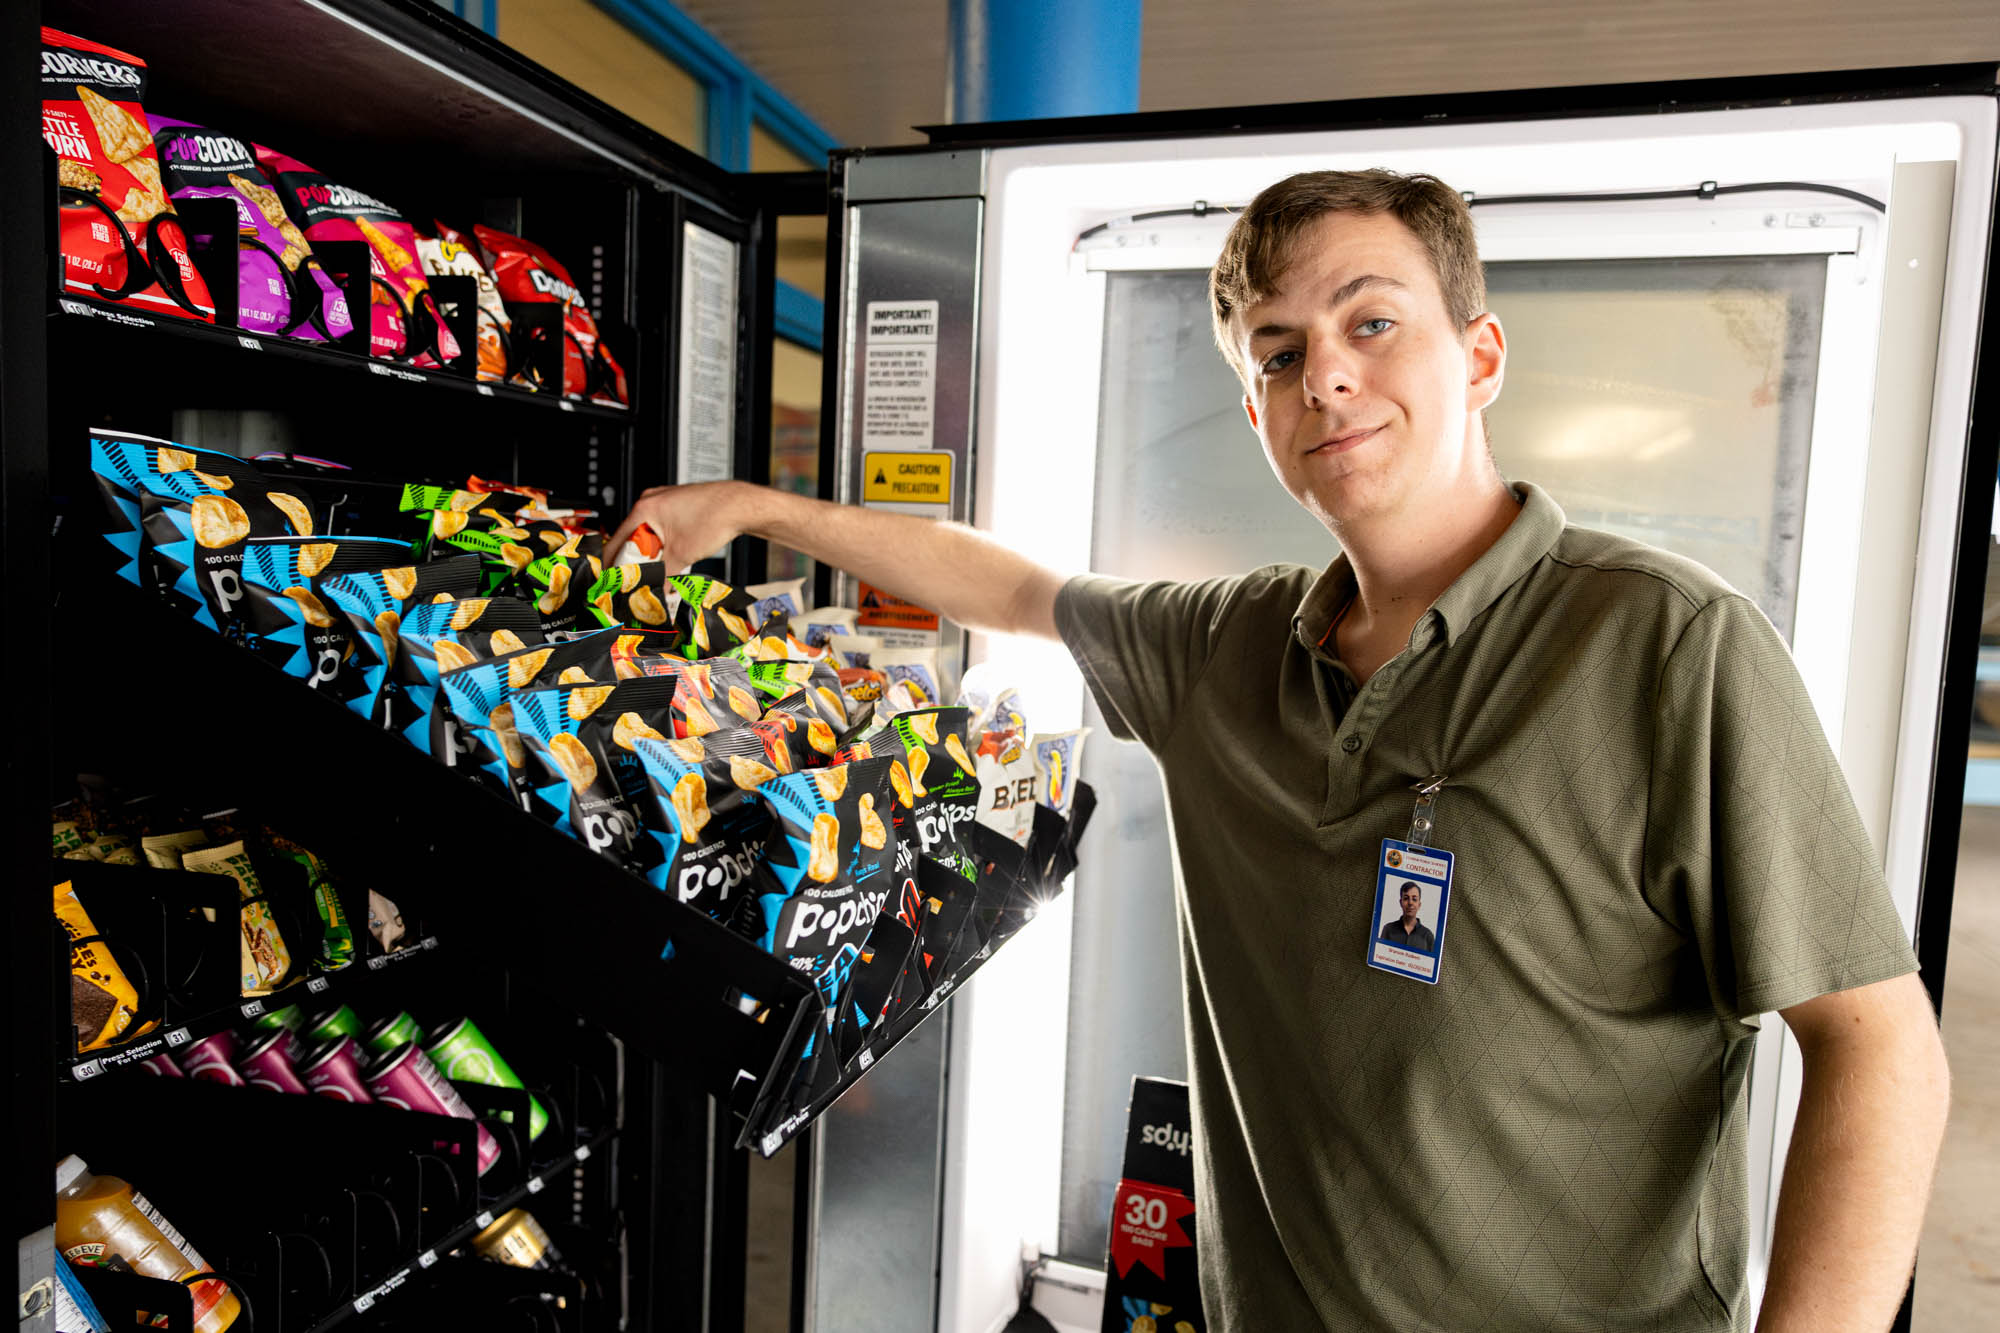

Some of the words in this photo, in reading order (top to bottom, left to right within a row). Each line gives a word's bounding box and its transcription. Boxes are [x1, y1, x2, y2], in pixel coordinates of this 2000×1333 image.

[173, 250, 189, 267] 130
[874, 309, 932, 320] IMPORTANT!
[870, 324, 934, 336] IMPORTANTE!
[898, 463, 941, 475] CAUTION
[892, 481, 940, 494] PRECAUTION
[204, 556, 223, 565] 100
[1406, 863, 1444, 878] CONTRACTOR
[247, 1003, 259, 1015] 32
[171, 1031, 185, 1043] 31
[102, 1053, 125, 1065] Press
[126, 1039, 162, 1056] Selection
[117, 1056, 131, 1066] For
[132, 1049, 154, 1061] Price
[80, 1065, 95, 1077] 30
[1141, 1122, 1193, 1156] hips
[1125, 1194, 1168, 1230] 30
